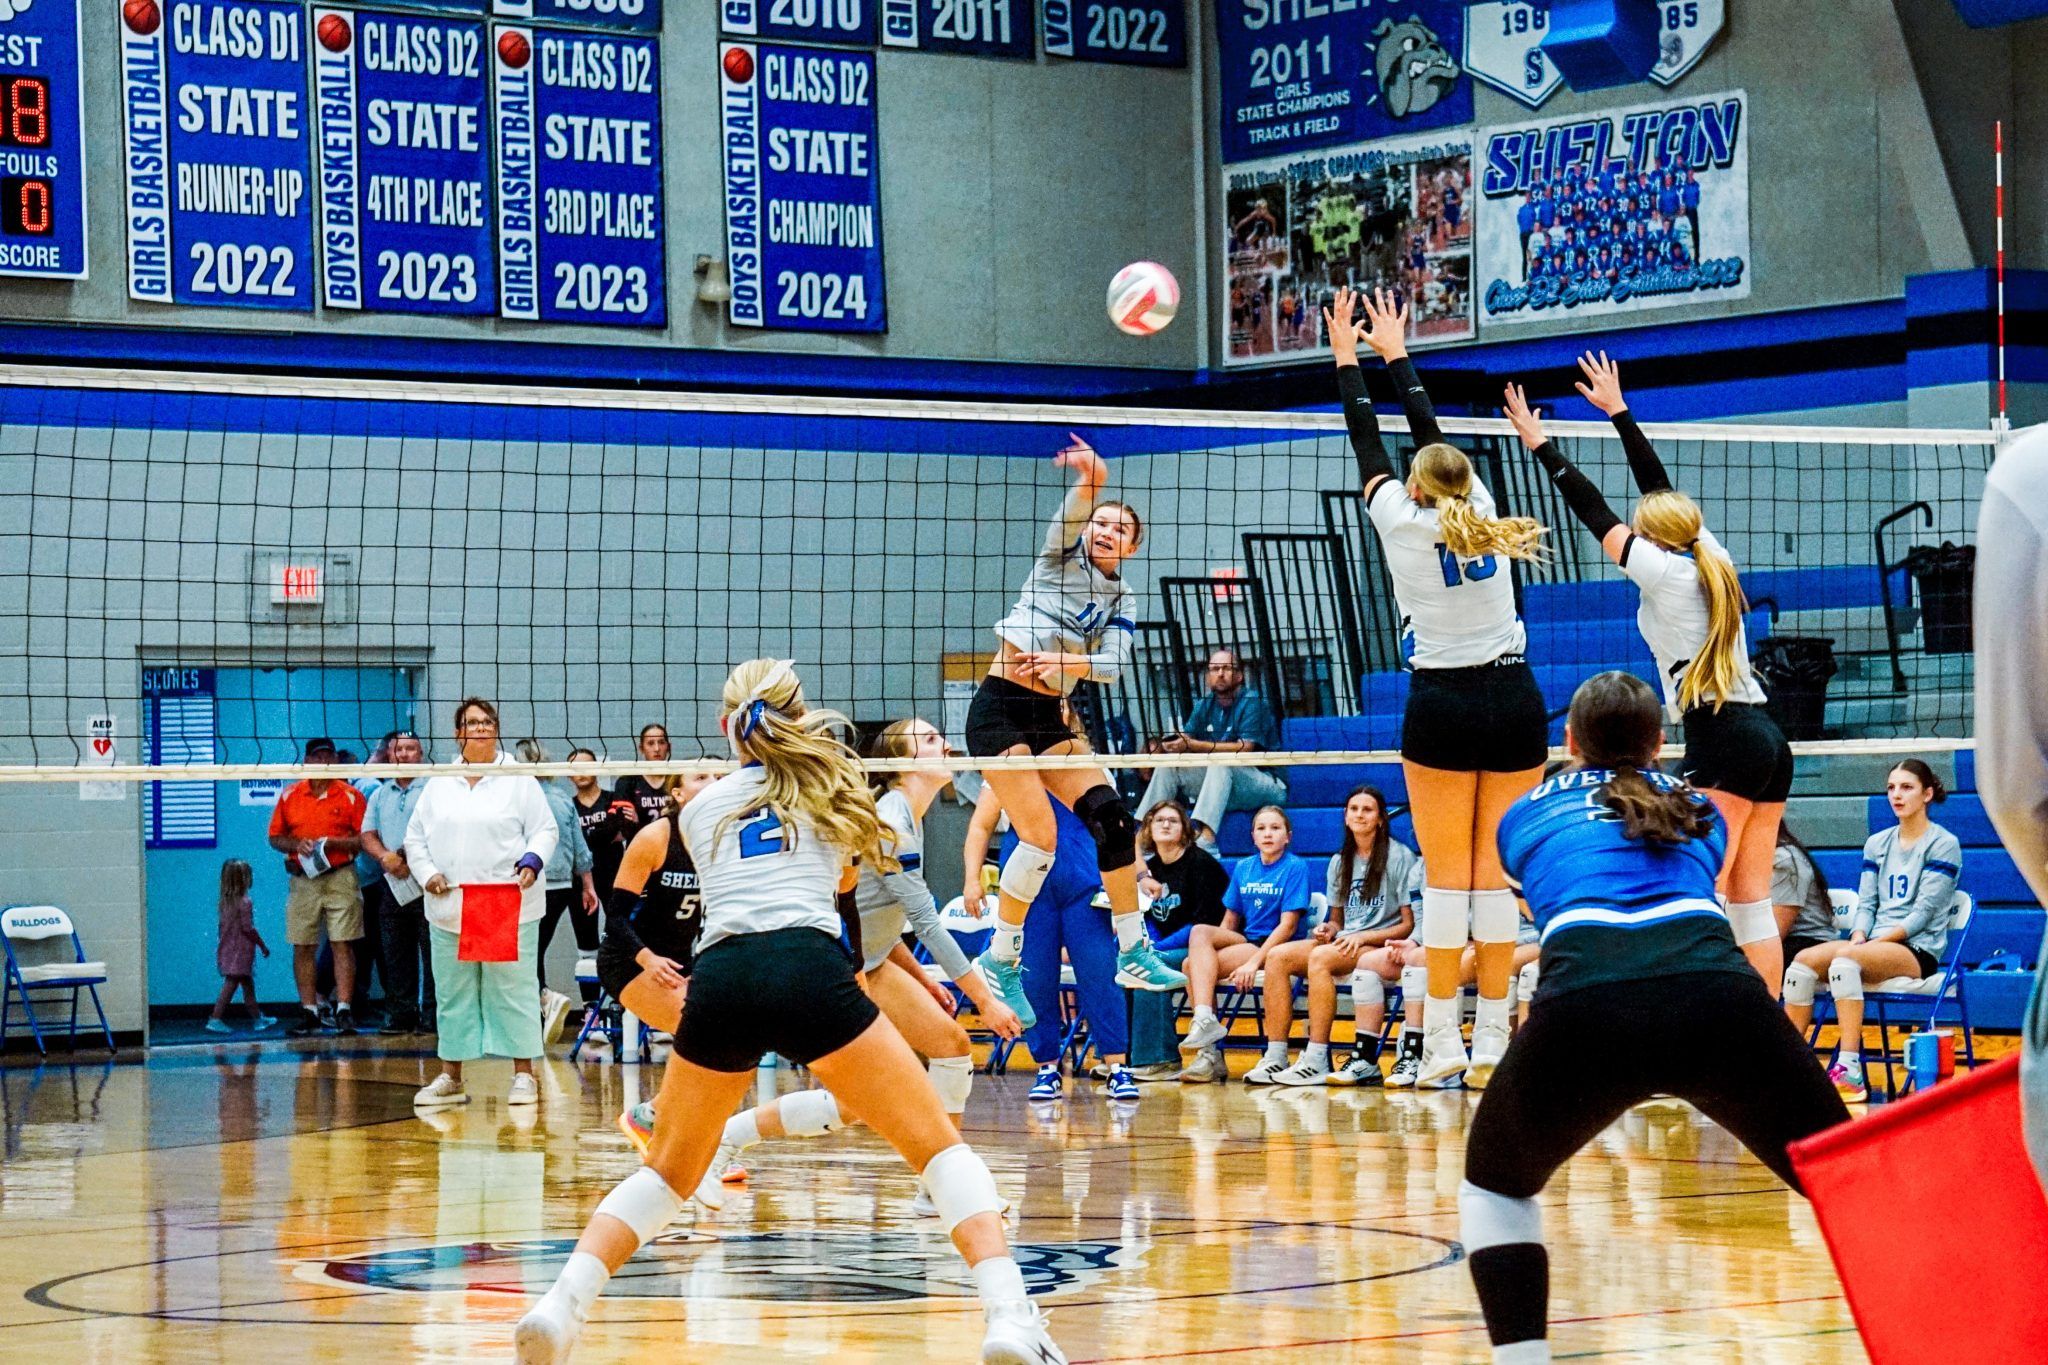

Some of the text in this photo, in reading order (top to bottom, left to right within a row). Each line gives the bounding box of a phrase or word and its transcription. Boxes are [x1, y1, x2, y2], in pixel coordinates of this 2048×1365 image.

[173, 2, 299, 62] CLASS D1
[931, 0, 1011, 44] 2011
[1087, 4, 1169, 53] 2022
[1502, 10, 1546, 36] 198
[1666, 2, 1699, 31] 85
[0, 34, 43, 67] ST
[363, 22, 480, 78] CLASS D2
[541, 38, 653, 93] CLASS D2
[1250, 35, 1332, 88] 2011
[764, 54, 869, 106] CLASS D2
[1274, 81, 1312, 99] GIRLS
[0, 79, 46, 144] 8
[178, 84, 300, 139] STATE
[367, 99, 479, 152] STATE
[1237, 91, 1350, 123] STATE CHAMPIONS
[1249, 128, 1291, 145] TRACK
[1304, 116, 1341, 136] FIELD
[125, 34, 167, 296] GIRLS BASKETBALL
[545, 113, 651, 166] STATE
[768, 127, 868, 177] STATE
[1484, 99, 1743, 200] SHELTON
[177, 162, 303, 217] RUNNER-UP
[320, 53, 358, 303] BOYS BASKETBALL
[367, 175, 484, 227] 4TH PLACE
[499, 69, 535, 313] GIRLS BASKETBALL
[726, 85, 759, 320] BOYS BASKETBALL
[21, 182, 47, 231] 0
[545, 188, 656, 240] 3RD PLACE
[768, 199, 874, 248] CHAMPION
[0, 244, 60, 268] SCORE
[190, 242, 296, 297] 2022
[377, 250, 478, 303] 2023
[554, 262, 648, 314] 2023
[777, 270, 867, 320] 2024
[283, 567, 316, 597] EXIT
[1075, 602, 1104, 634] 11
[92, 720, 113, 729] AED
[739, 804, 791, 860] 2
[660, 871, 700, 889] SHEL
[1888, 874, 1909, 899] 13
[10, 917, 61, 928] BULLDOGS
[675, 894, 701, 920] 5
